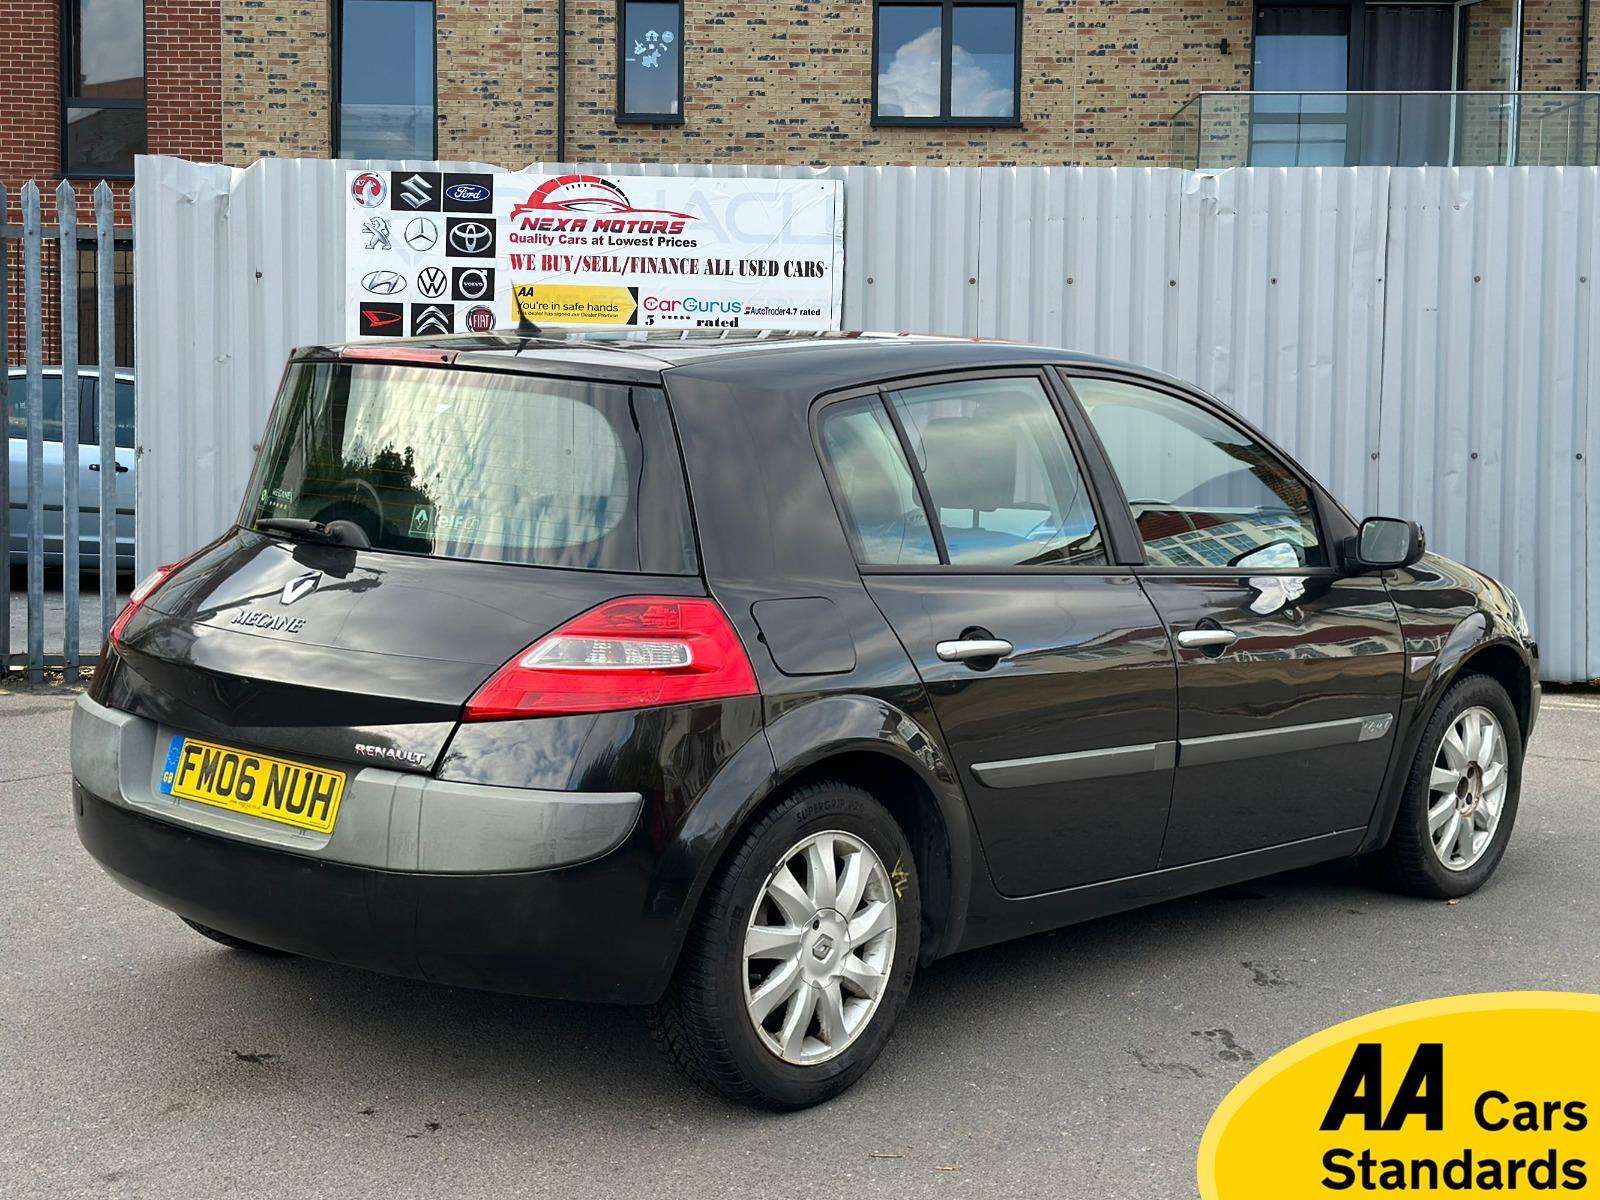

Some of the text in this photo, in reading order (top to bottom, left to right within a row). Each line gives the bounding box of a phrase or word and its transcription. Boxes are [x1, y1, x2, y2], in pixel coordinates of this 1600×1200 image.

[454, 186, 481, 199] Ford
[520, 217, 685, 234] NEXA MOTORS
[509, 233, 697, 248] Quality Cars at Lowest Prices
[509, 254, 536, 270] WE
[704, 258, 734, 276] ALL
[739, 260, 780, 277] USED
[784, 260, 825, 278] CARS
[518, 286, 534, 297] AA
[551, 302, 560, 310] in
[563, 302, 584, 310] safe
[587, 303, 618, 312] hands
[643, 296, 742, 313] CarGurus
[473, 314, 490, 328] FIAT
[645, 314, 739, 328] 5 rated
[355, 744, 426, 764] RENAULT
[178, 744, 338, 821] FM06 NUH
